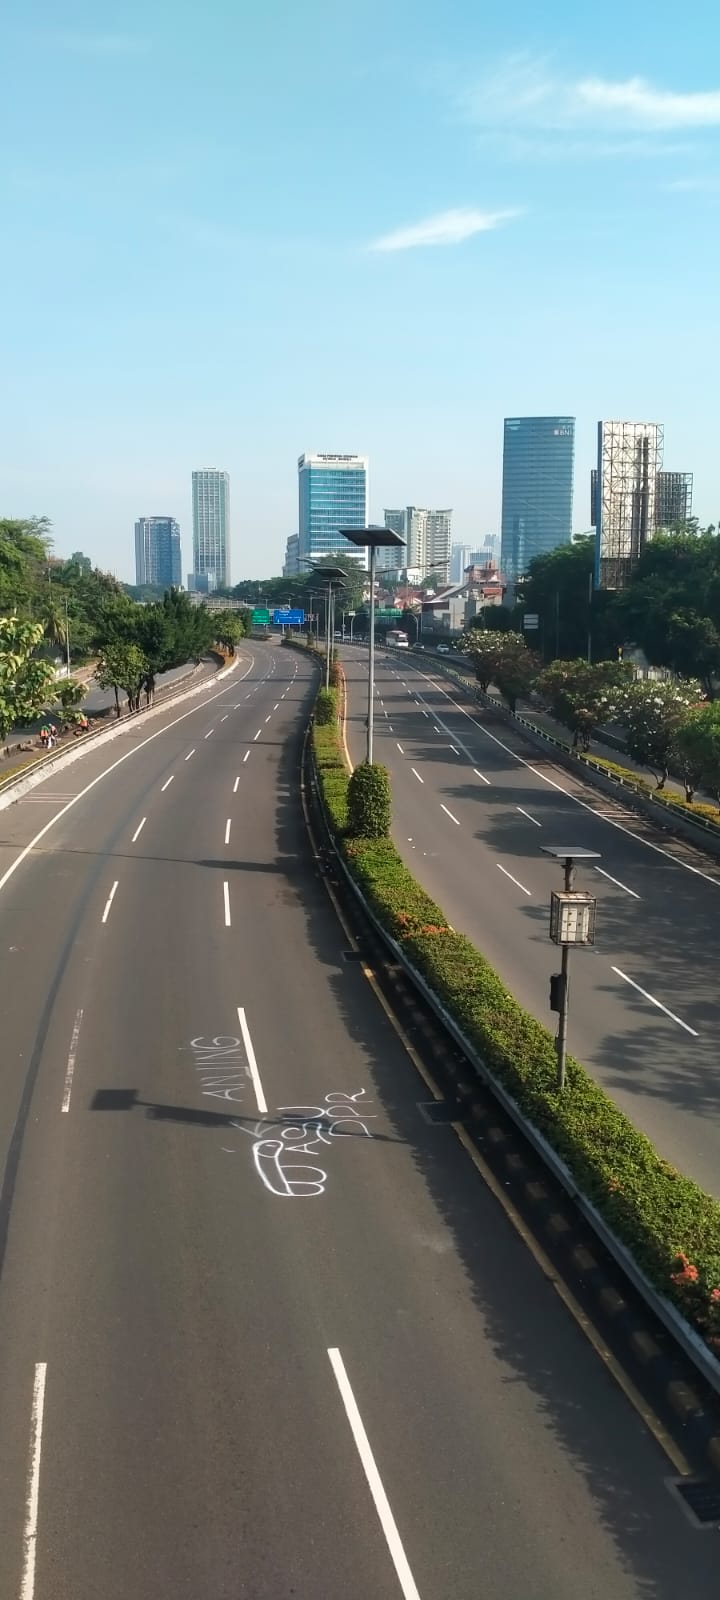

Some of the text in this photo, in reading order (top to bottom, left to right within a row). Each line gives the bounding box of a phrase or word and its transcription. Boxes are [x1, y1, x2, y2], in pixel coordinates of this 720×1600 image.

[190, 1036, 251, 1102] ANJING
[277, 1106, 331, 1154] ASU
[325, 1088, 376, 1137] DPR
